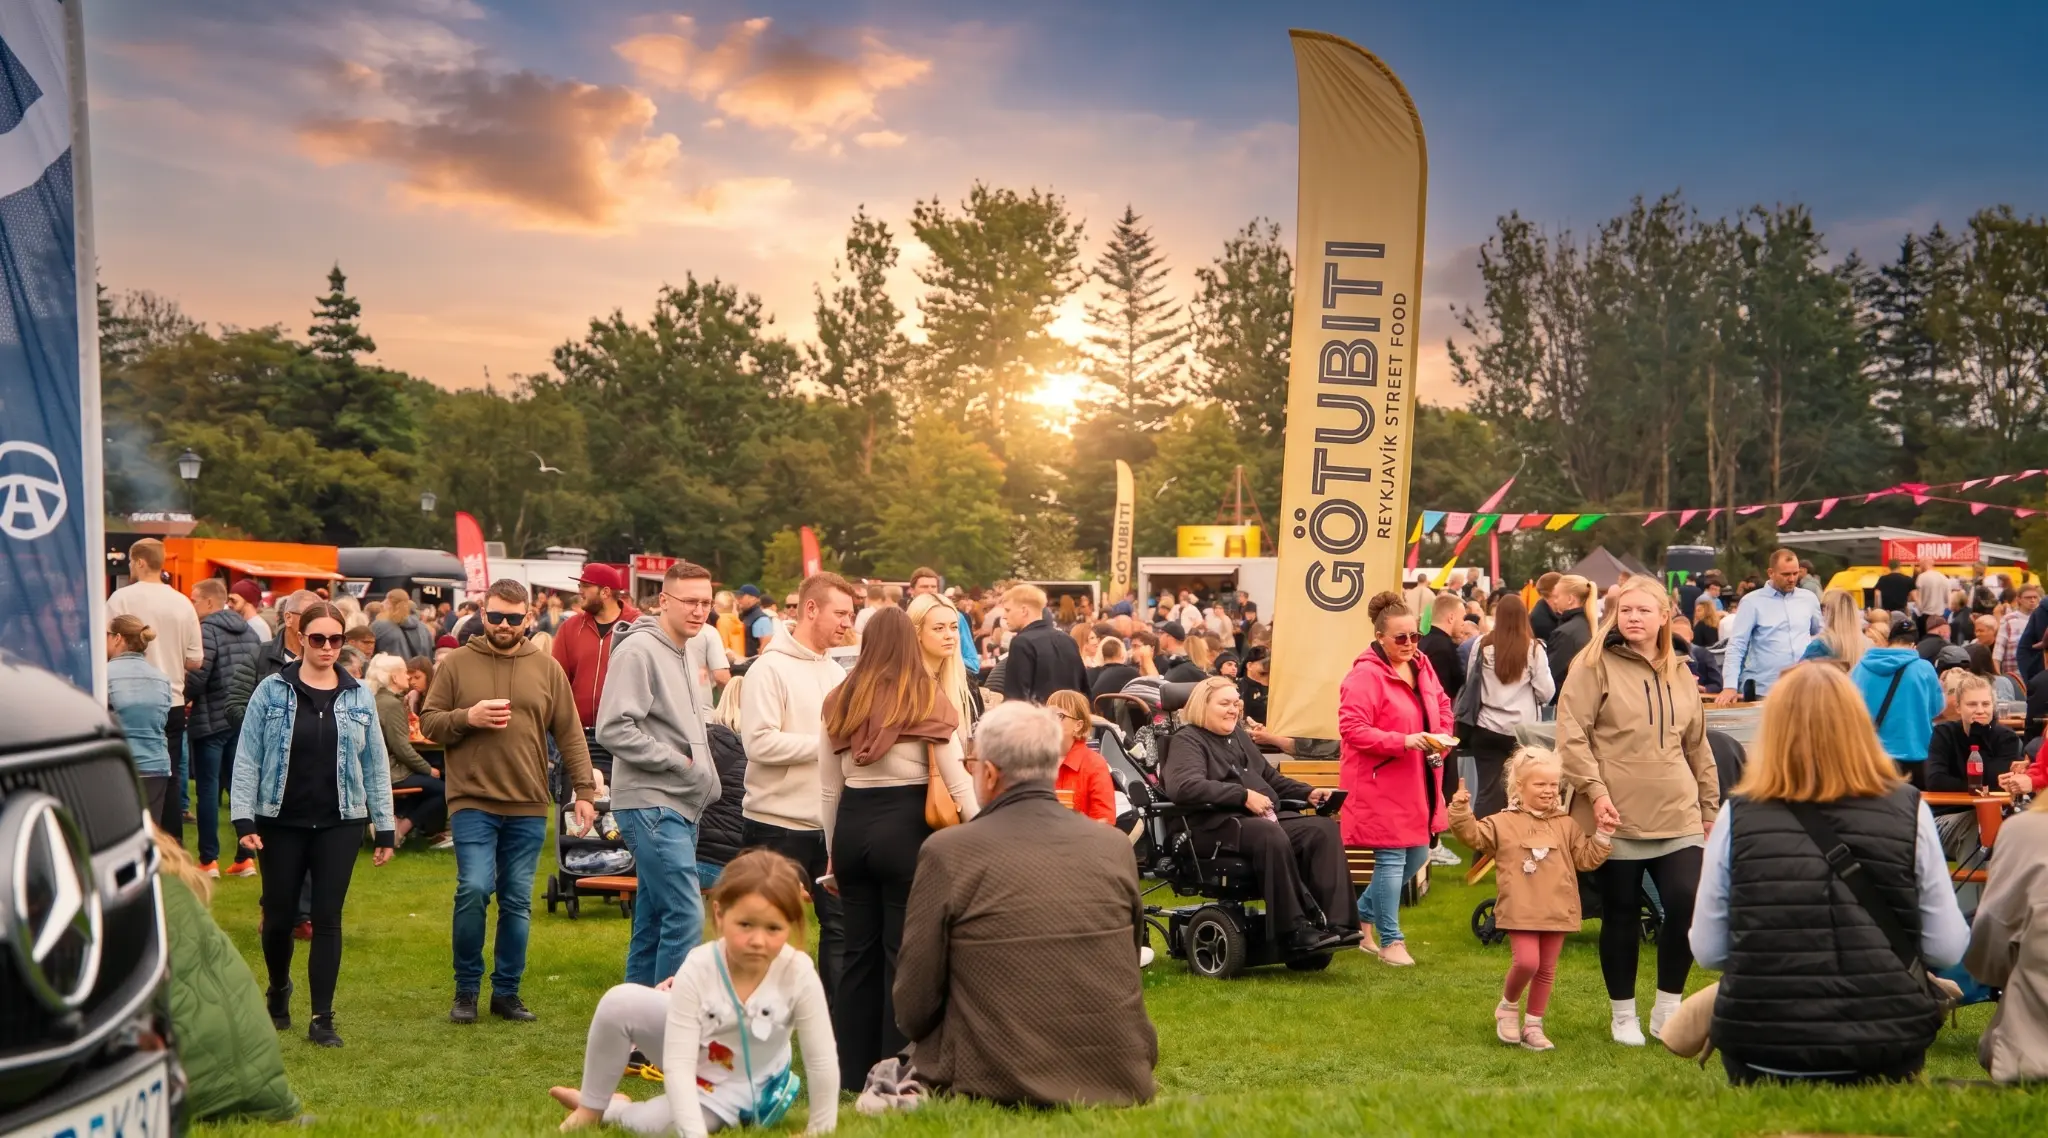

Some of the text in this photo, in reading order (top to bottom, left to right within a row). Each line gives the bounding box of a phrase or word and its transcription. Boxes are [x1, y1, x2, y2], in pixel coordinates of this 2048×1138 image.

[1293, 241, 1386, 612] GÖTUBITI
[1377, 292, 1407, 539] REYKJAVÍK STREET FOOD
